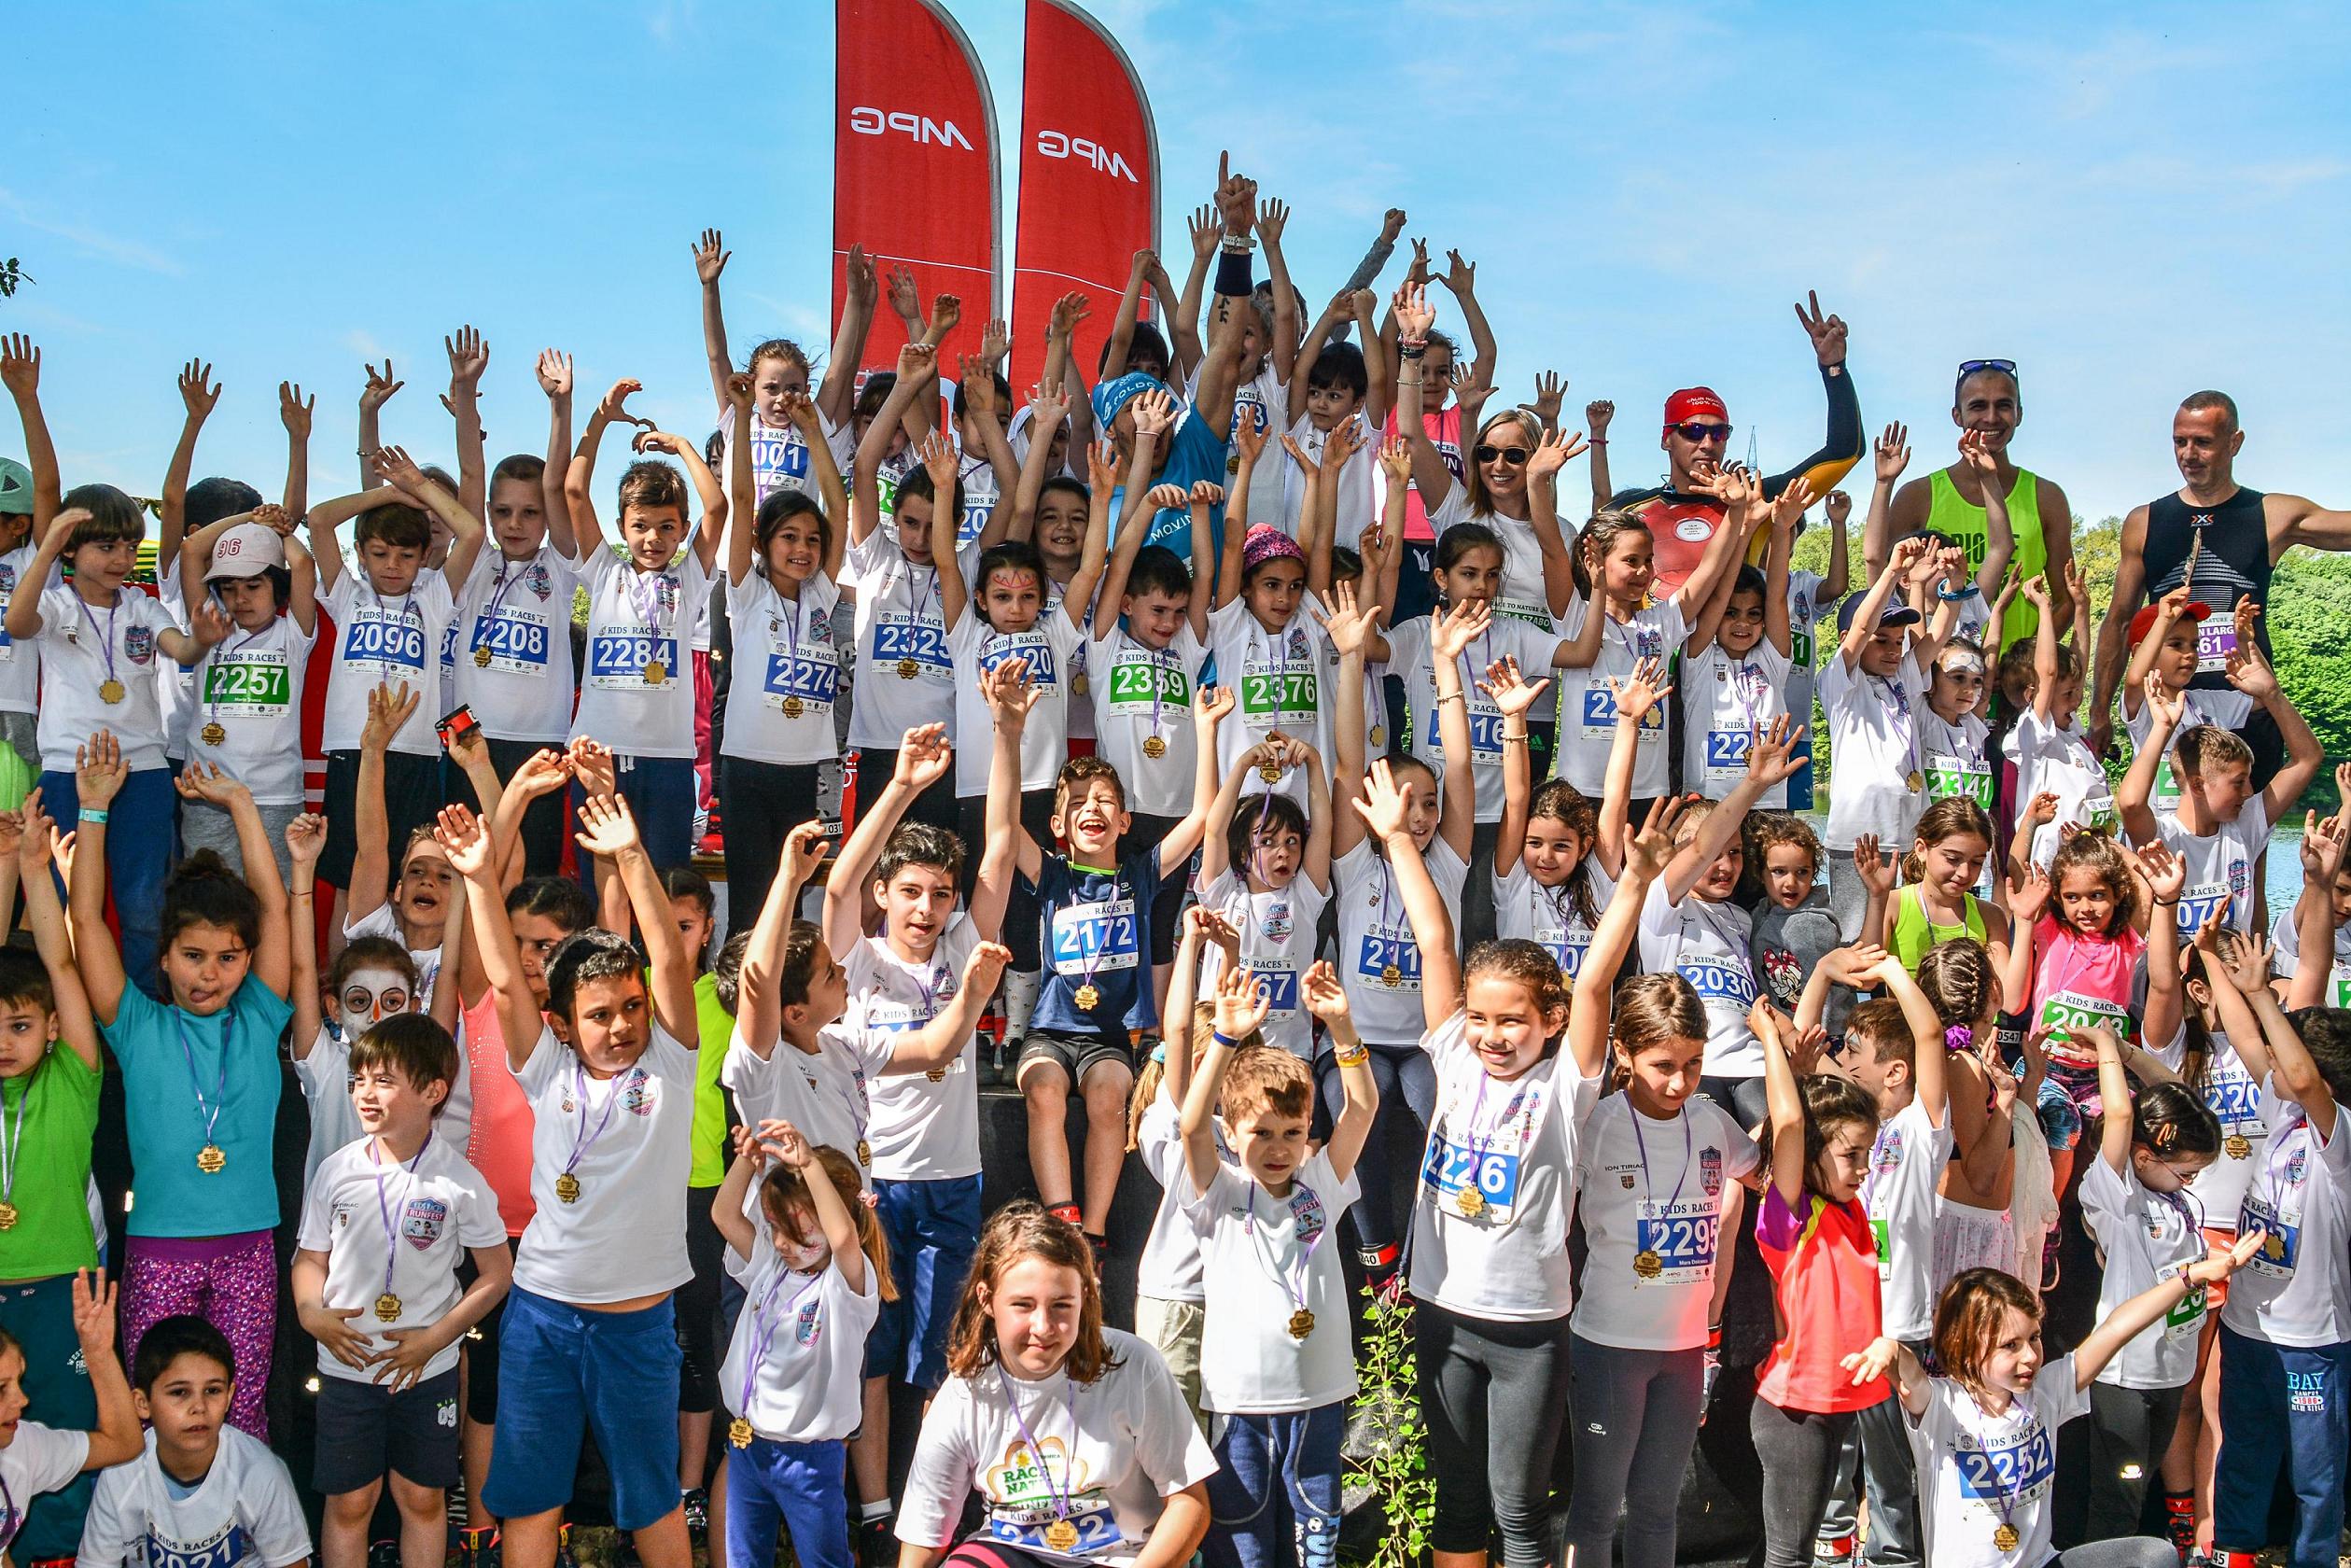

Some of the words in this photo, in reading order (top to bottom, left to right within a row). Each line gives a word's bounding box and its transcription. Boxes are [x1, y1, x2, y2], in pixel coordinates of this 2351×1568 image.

[1238, 391, 1256, 399] ACES
[750, 441, 800, 470] 001
[878, 469, 898, 482] ACES
[1150, 514, 1193, 542] MOVIN
[217, 538, 242, 558] 96
[362, 610, 381, 620] KIDS
[385, 613, 415, 625] RACES
[511, 609, 536, 621] RACES
[893, 614, 916, 623] KIDS
[919, 617, 943, 627] RACE
[350, 623, 421, 659] 2096
[476, 619, 543, 654] 2208
[608, 626, 627, 635] KIDS
[632, 626, 661, 637] RACES
[1018, 636, 1043, 644] RACES
[223, 653, 244, 662] KIDS
[248, 653, 276, 662] RACES
[596, 638, 671, 667] 2284
[815, 651, 836, 661] RACES
[987, 648, 1052, 675] 220
[773, 658, 836, 694] 2274
[1258, 664, 1280, 672] KIDS
[1284, 664, 1308, 672] RACES
[211, 667, 284, 695] 2257
[1116, 666, 1183, 697] 2359
[1250, 677, 1316, 705] 2376
[1474, 704, 1501, 714] RACES
[1928, 773, 1992, 801] 2341
[2190, 887, 2218, 896] RACES
[1095, 904, 1120, 915] RACES
[1059, 917, 1133, 953] 2172
[1252, 959, 1282, 969] RACES
[1366, 939, 1417, 972] 211
[1694, 955, 1716, 965] KIDS
[1719, 959, 1744, 973] RACES
[1686, 966, 1753, 1001] 2030
[883, 1009, 908, 1020] KIDS
[912, 1006, 939, 1018] RACES
[2065, 995, 2089, 1008] KIDS
[2092, 999, 2119, 1012] RACES
[2207, 1083, 2261, 1115] 220
[1426, 1137, 1507, 1194] 2226
[410, 1209, 443, 1221] RUNFEST
[1660, 1206, 1687, 1214] KIDS
[1692, 1202, 1714, 1213] RACES
[1651, 1218, 1717, 1257] 2295
[2287, 1371, 2325, 1390] BAY
[1966, 1435, 2049, 1490] 2252
[1010, 1511, 1037, 1522] KIDS
[1001, 1515, 1111, 1547] 212
[157, 1532, 178, 1550] KIDS
[183, 1531, 222, 1551] RACES
